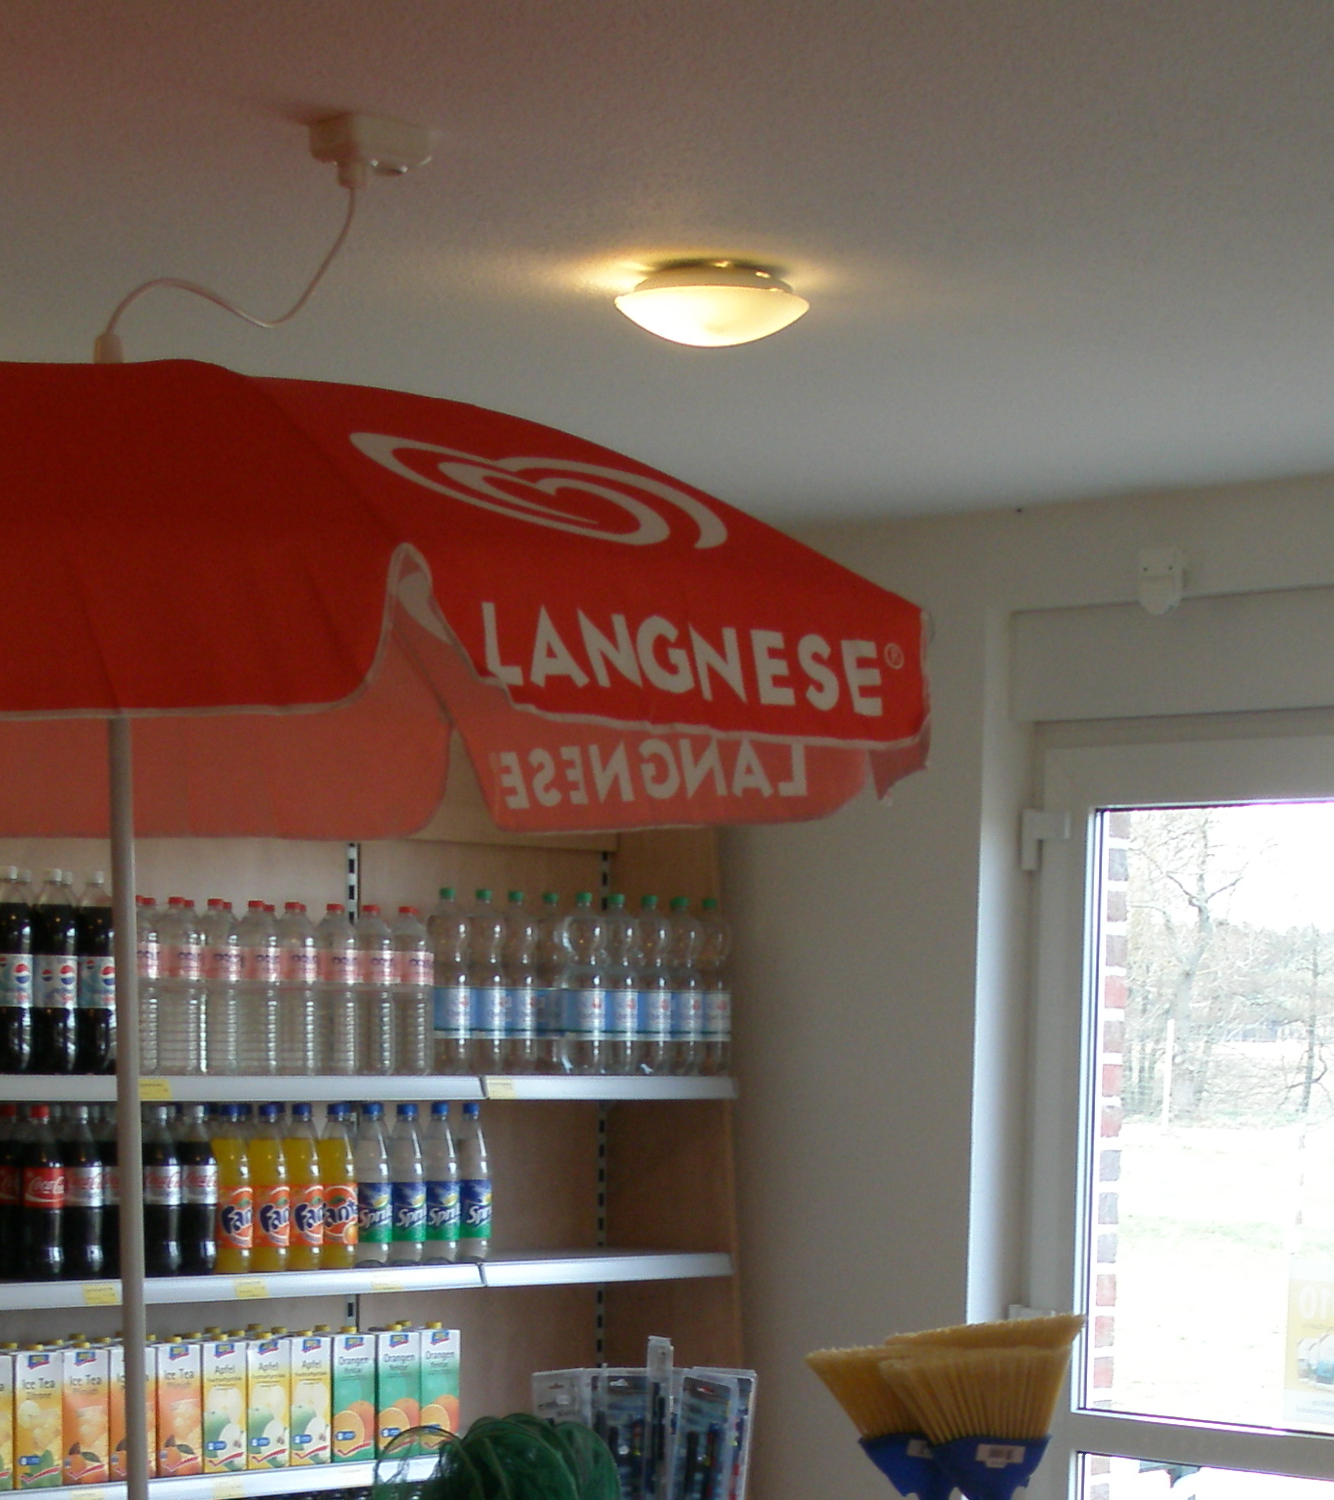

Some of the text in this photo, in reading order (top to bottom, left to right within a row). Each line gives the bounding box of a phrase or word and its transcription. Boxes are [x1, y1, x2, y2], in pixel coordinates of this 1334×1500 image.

[480, 601, 885, 718] LANGNESE
[338, 1356, 369, 1366] Orangen
[383, 1353, 416, 1364] Orangen
[425, 1351, 456, 1361] Orangen
[258, 1362, 279, 1372] Apfel
[302, 1359, 322, 1370] Apfel
[164, 1368, 194, 1381] Ice Tea
[215, 1365, 236, 1376] Apfel
[22, 1377, 55, 1390] Ice Tea
[69, 1374, 102, 1386] Ice Tea
